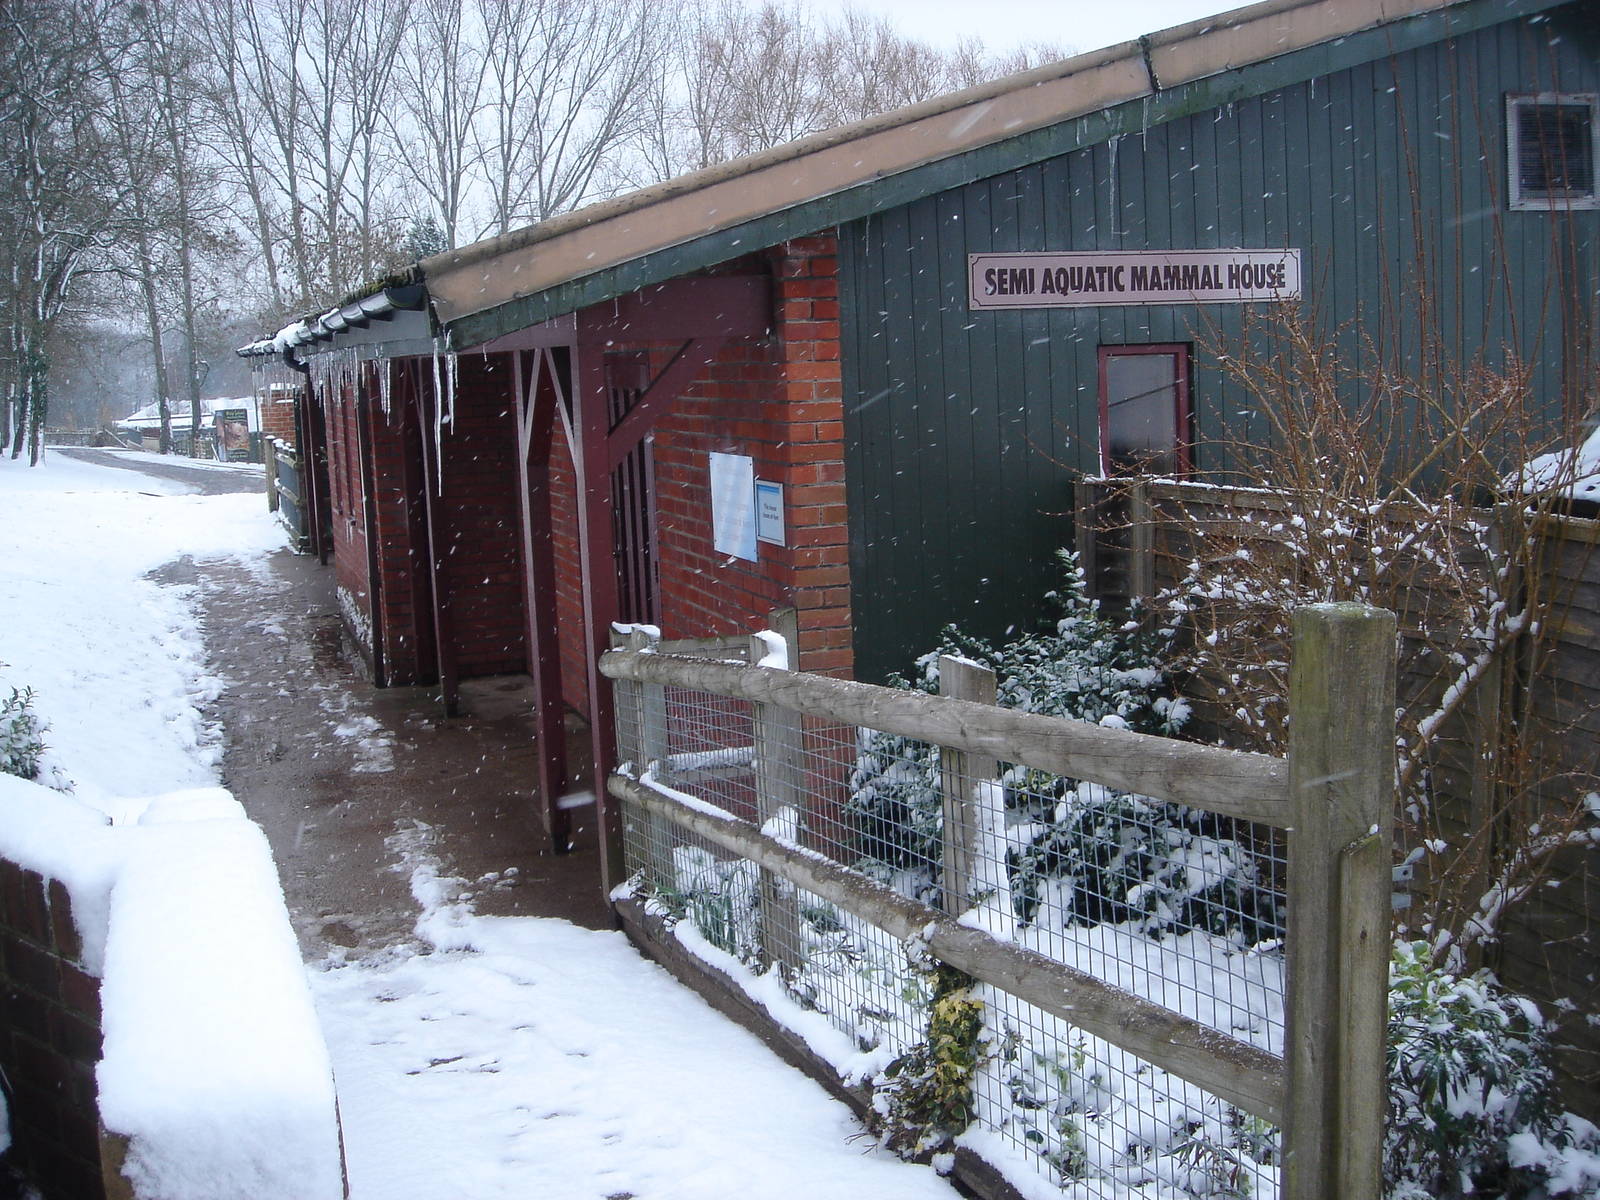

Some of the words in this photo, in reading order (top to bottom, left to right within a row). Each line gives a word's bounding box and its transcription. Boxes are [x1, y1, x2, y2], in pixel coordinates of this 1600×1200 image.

[985, 267, 1034, 295] SEMI
[1041, 266, 1125, 296] AQUATIC
[1131, 264, 1223, 291] MAMMAL
[1228, 262, 1286, 290] HOUSE
